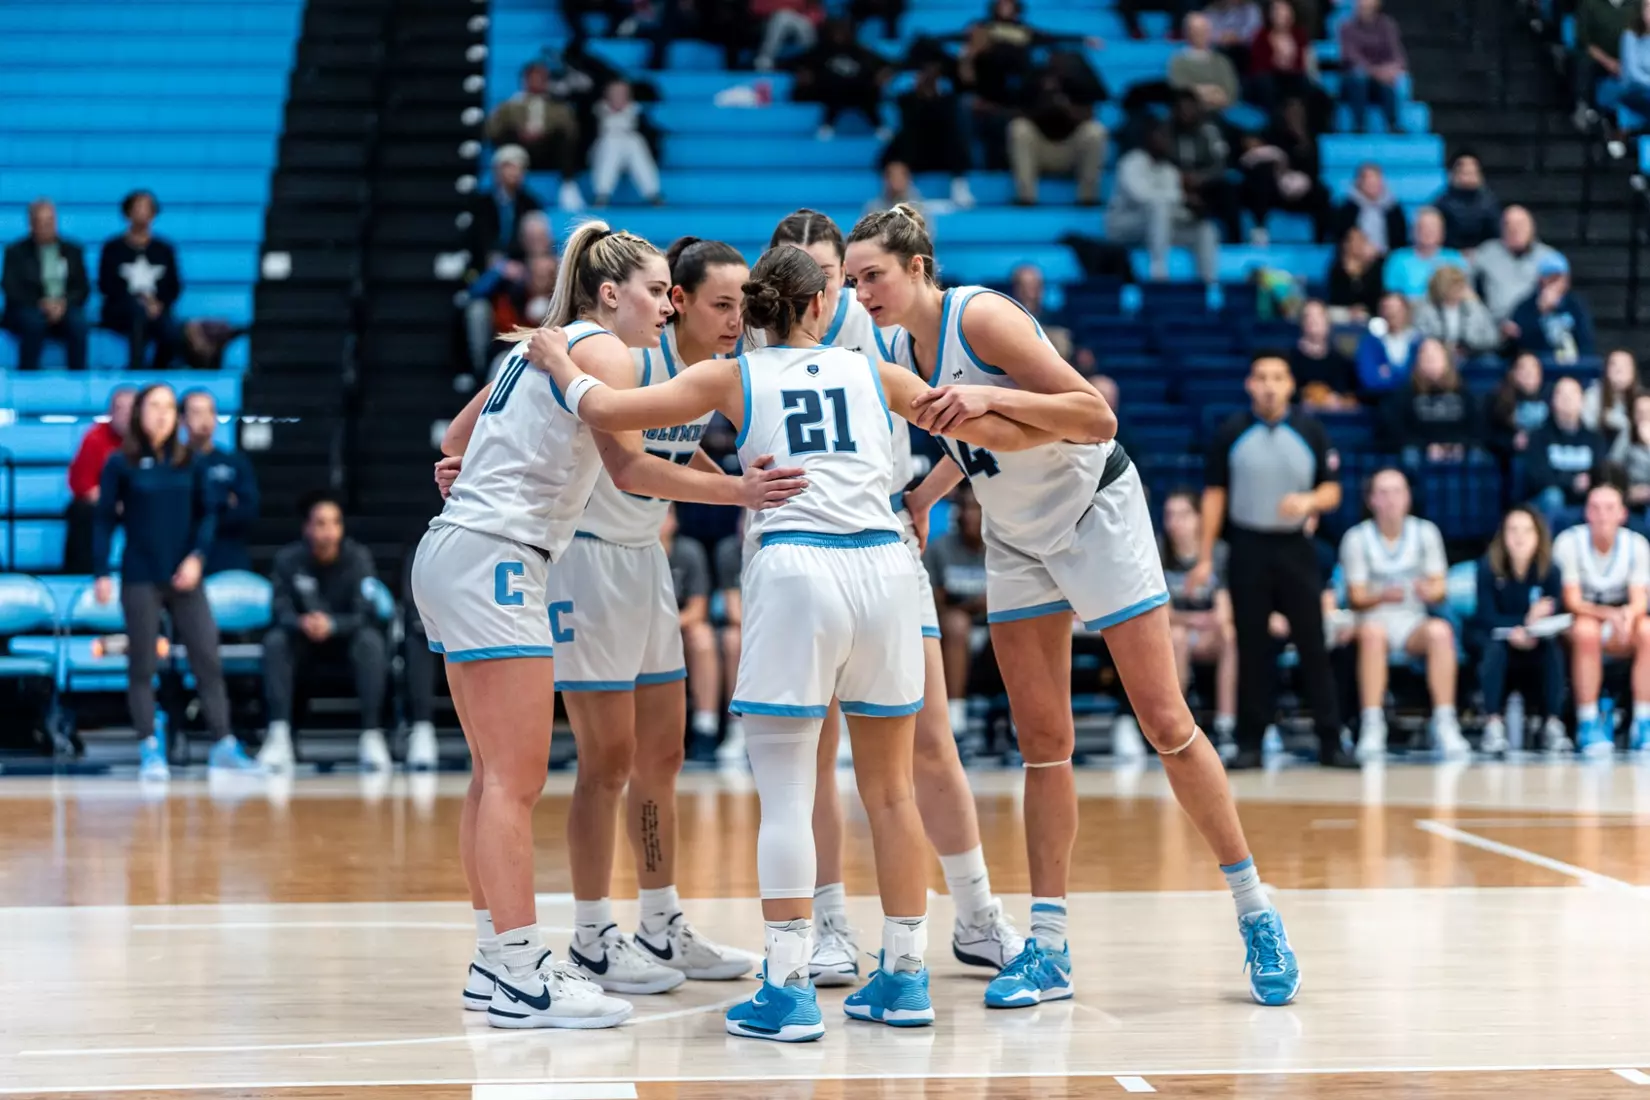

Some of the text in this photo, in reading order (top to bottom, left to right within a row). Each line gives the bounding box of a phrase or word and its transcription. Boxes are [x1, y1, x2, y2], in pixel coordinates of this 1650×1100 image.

[481, 355, 529, 414] 10
[642, 424, 708, 442] OLUM
[781, 387, 857, 456] 21
[494, 561, 525, 607] C
[548, 600, 575, 643] C
